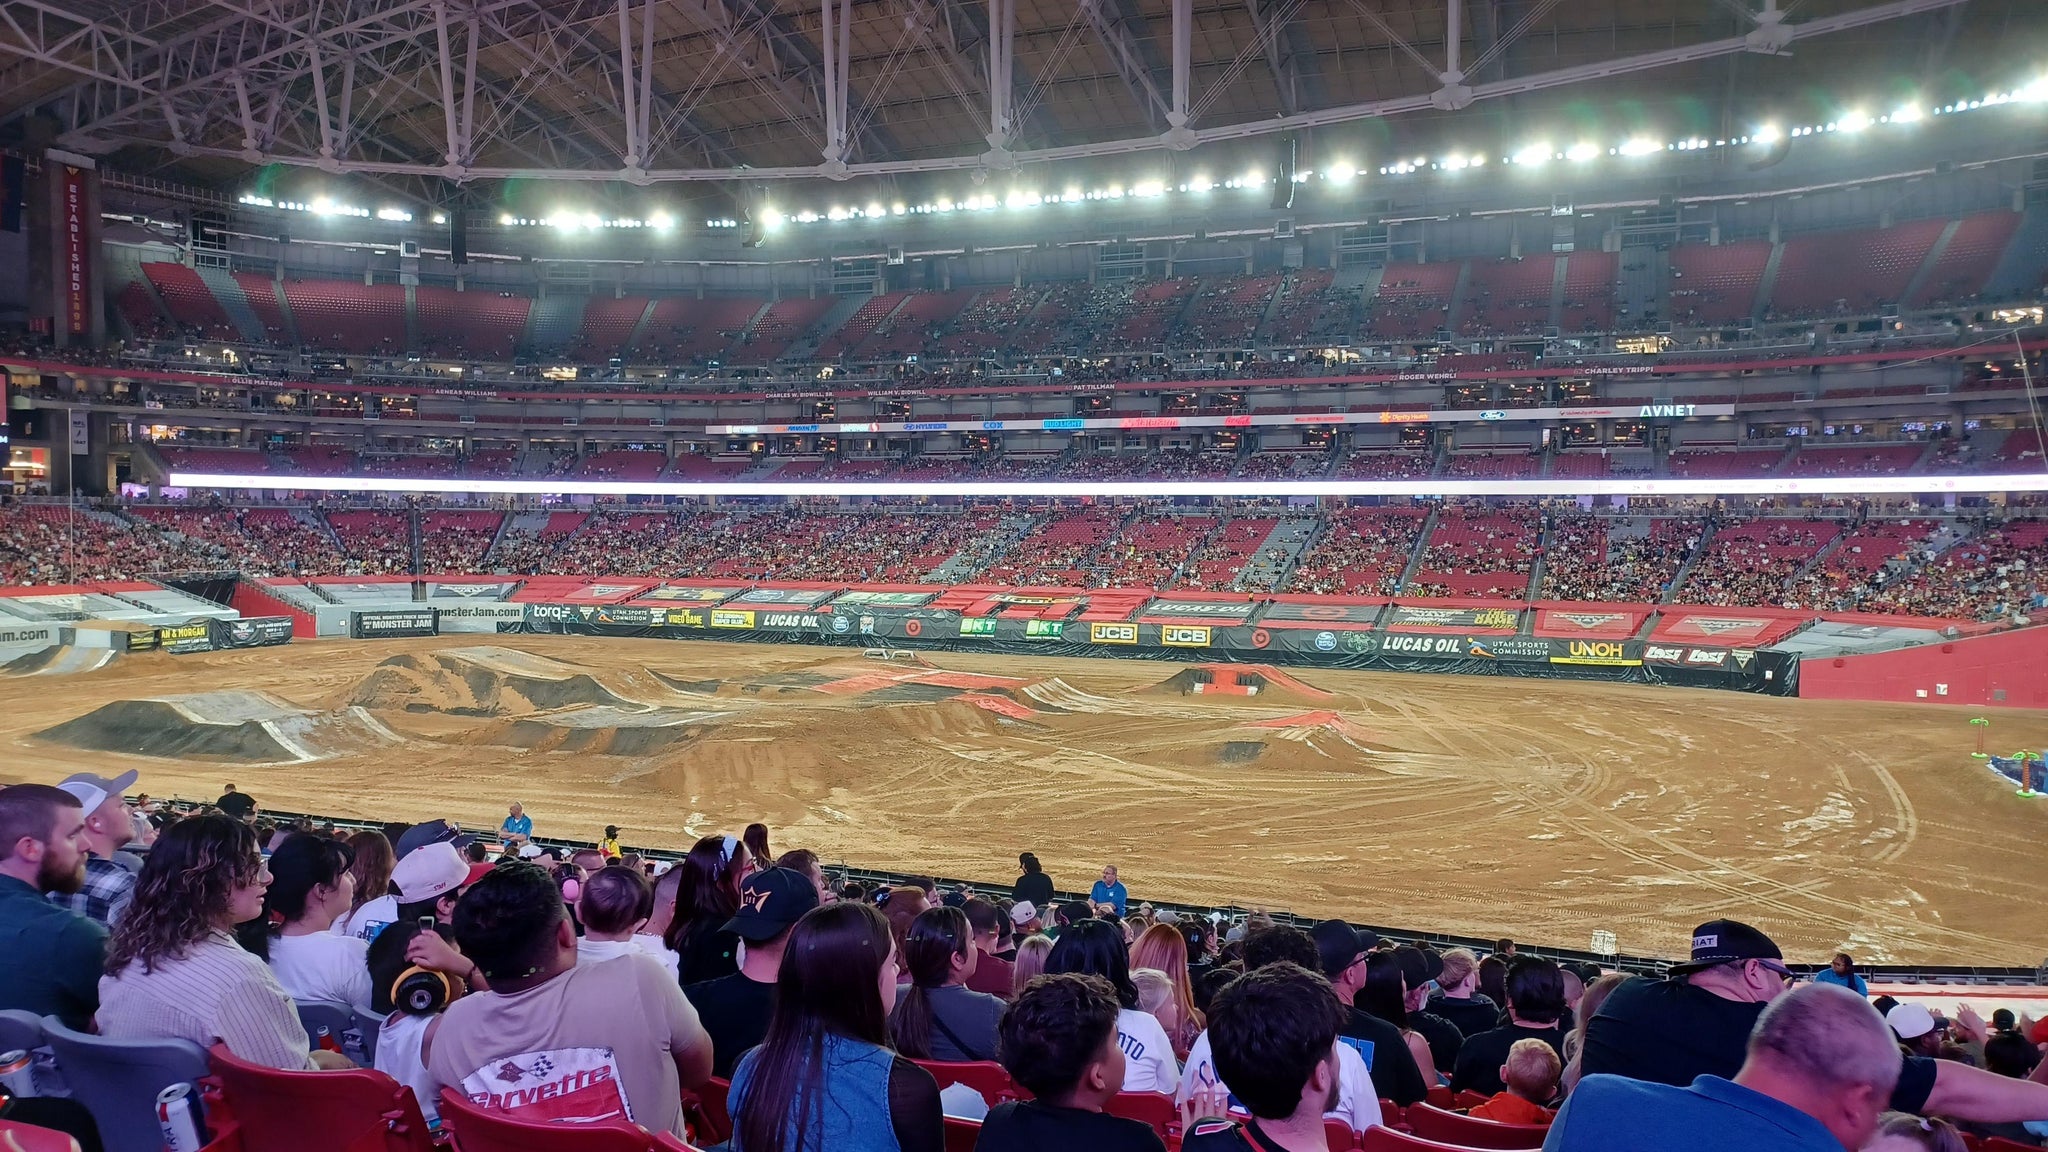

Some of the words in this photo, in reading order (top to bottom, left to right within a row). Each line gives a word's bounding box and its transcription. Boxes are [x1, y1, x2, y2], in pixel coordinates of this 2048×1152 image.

[69, 184, 81, 290] ESTABLISHED
[232, 377, 253, 385] OLLIE
[254, 379, 284, 387] MATSON
[1640, 405, 1696, 418] AVNET
[983, 421, 1004, 429] COX
[1044, 420, 1058, 428] BUD
[427, 606, 520, 617] onsterJam.com
[1149, 604, 1217, 612] LUCAS
[372, 620, 412, 629] MONSTER
[414, 620, 432, 628] JAM
[668, 615, 685, 624] VIDEO
[686, 615, 702, 625] GAME
[764, 615, 800, 626] LUCAS
[0, 629, 48, 642] m.com
[171, 629, 177, 638] &
[178, 626, 206, 638] MORGAN
[1094, 627, 1135, 640] JCB
[1166, 629, 1207, 642] JCB
[1383, 637, 1433, 652] LUCAS
[1517, 641, 1549, 649] SPORTS
[1569, 641, 1623, 657] UNOH
[468, 1064, 612, 1110] Corvette
